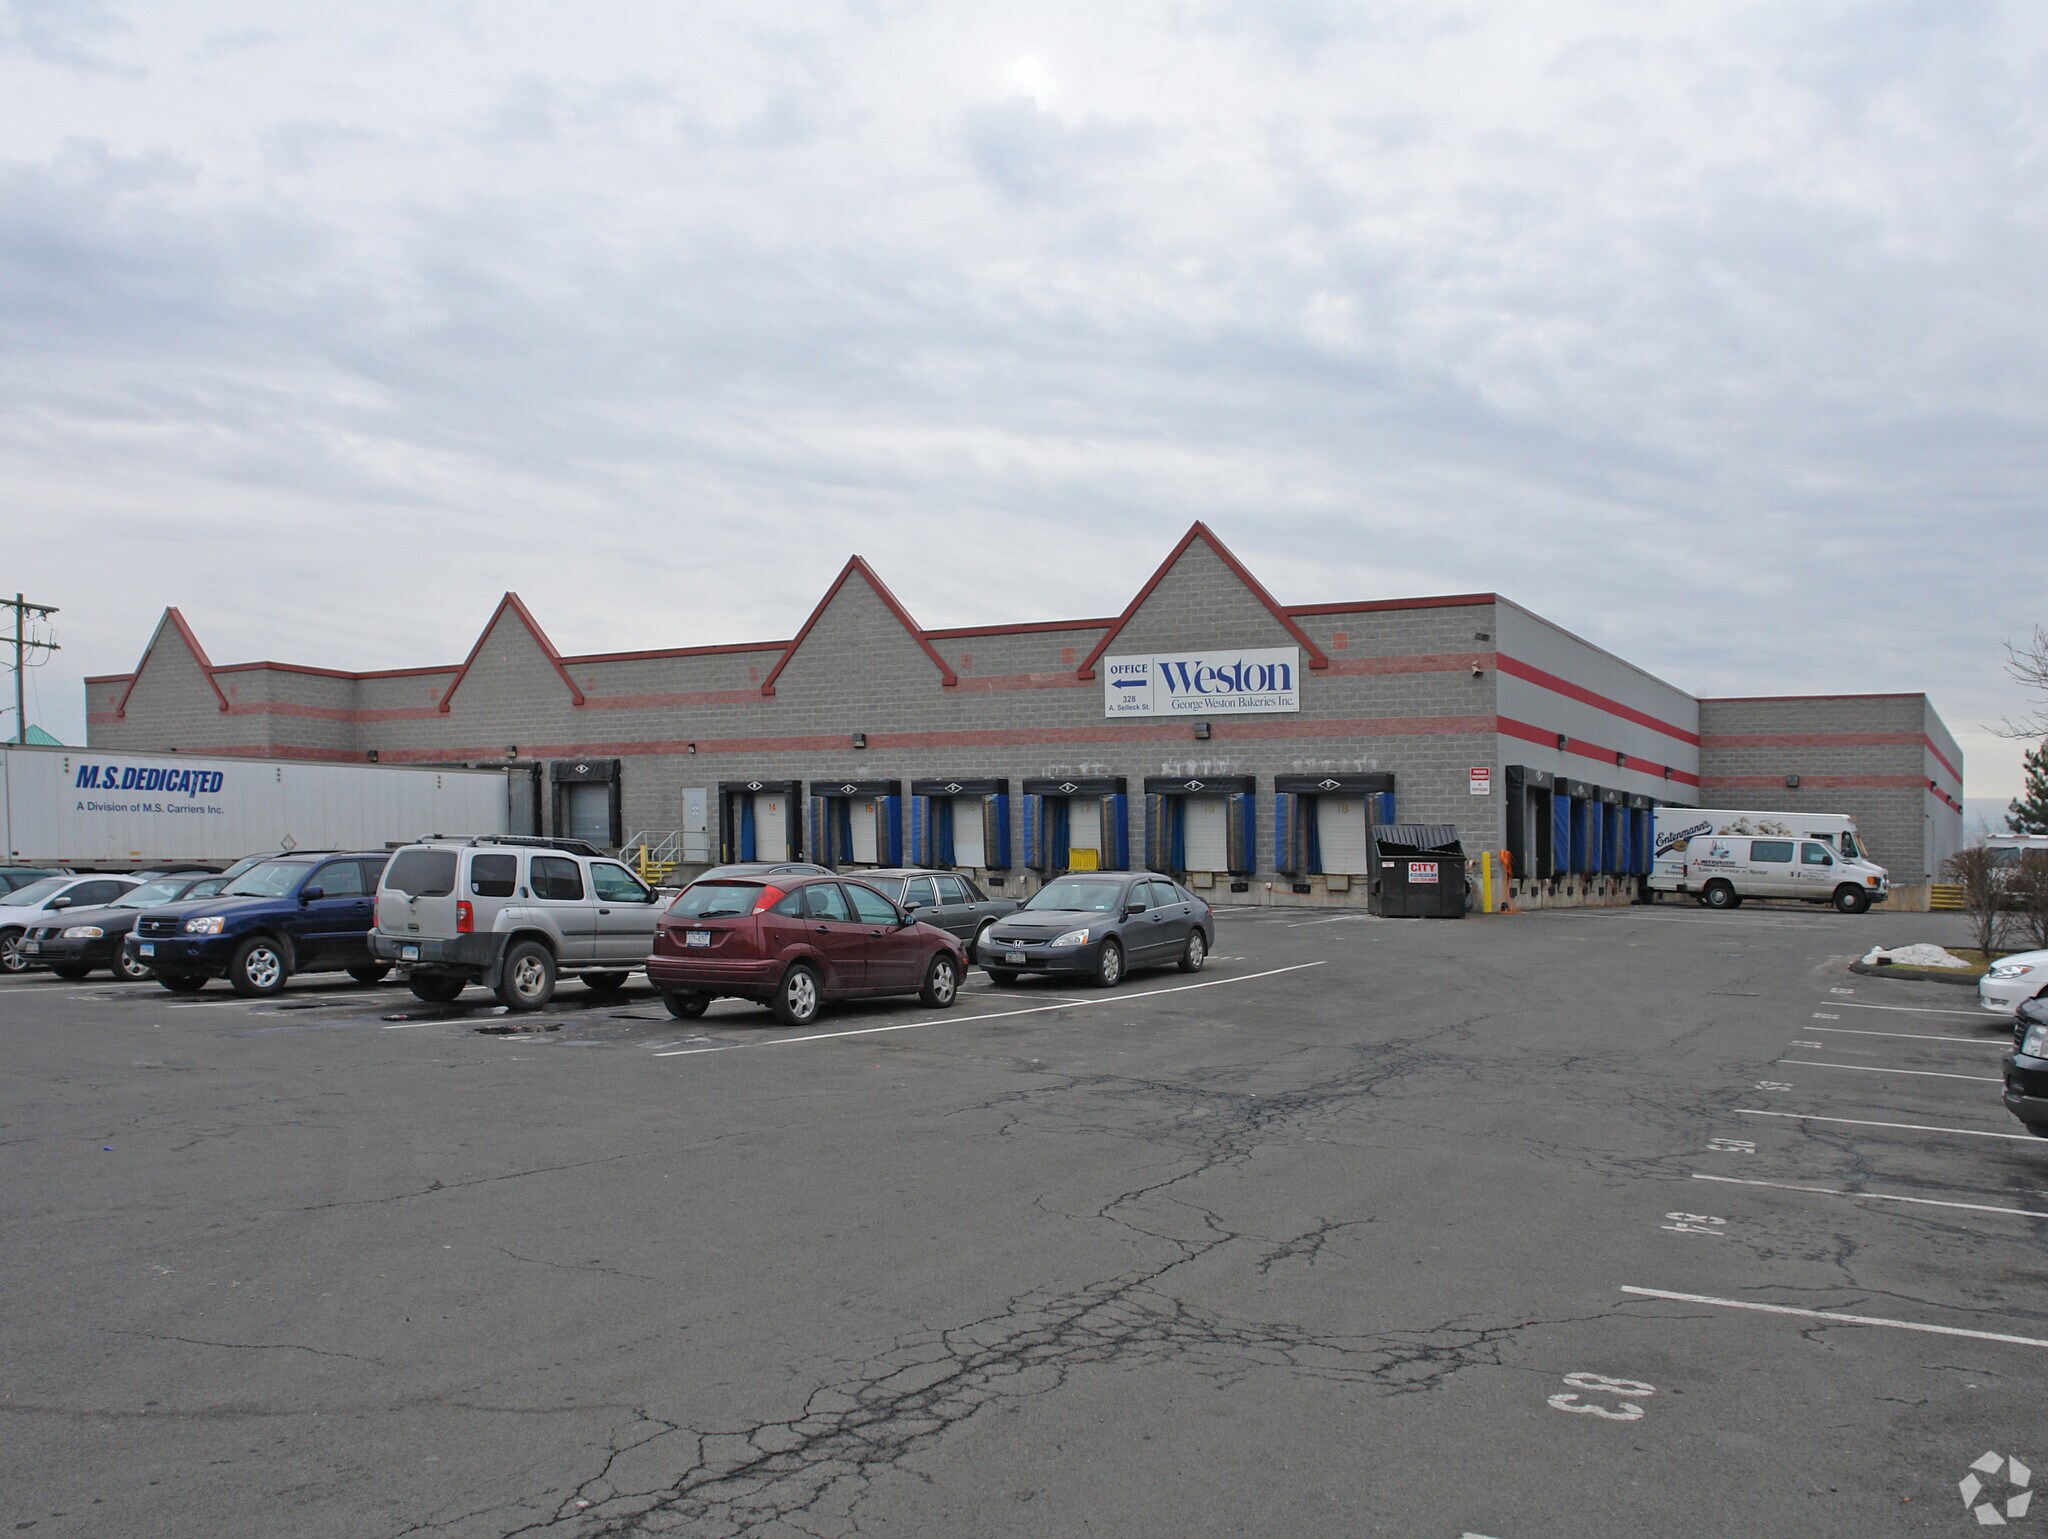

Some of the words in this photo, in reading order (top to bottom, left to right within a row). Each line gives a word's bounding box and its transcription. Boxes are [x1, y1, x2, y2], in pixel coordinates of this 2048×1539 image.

[1110, 664, 1148, 674] OFFICE
[1158, 658, 1292, 694] Weston
[1122, 695, 1136, 703] 328
[1171, 698, 1203, 711] George
[1204, 698, 1236, 708] Weston
[1238, 696, 1276, 707] Bakeries
[1278, 696, 1294, 706] Inc.
[1117, 703, 1140, 711] Selleck
[76, 801, 85, 811] A
[87, 802, 127, 811] Division
[130, 802, 140, 812] of
[143, 803, 164, 813] M.S.
[167, 804, 205, 813] Carriers
[207, 805, 224, 814] Inc.
[768, 803, 777, 812] 14
[1410, 863, 1435, 872] CITY
[1546, 1372, 1656, 1421] 83
